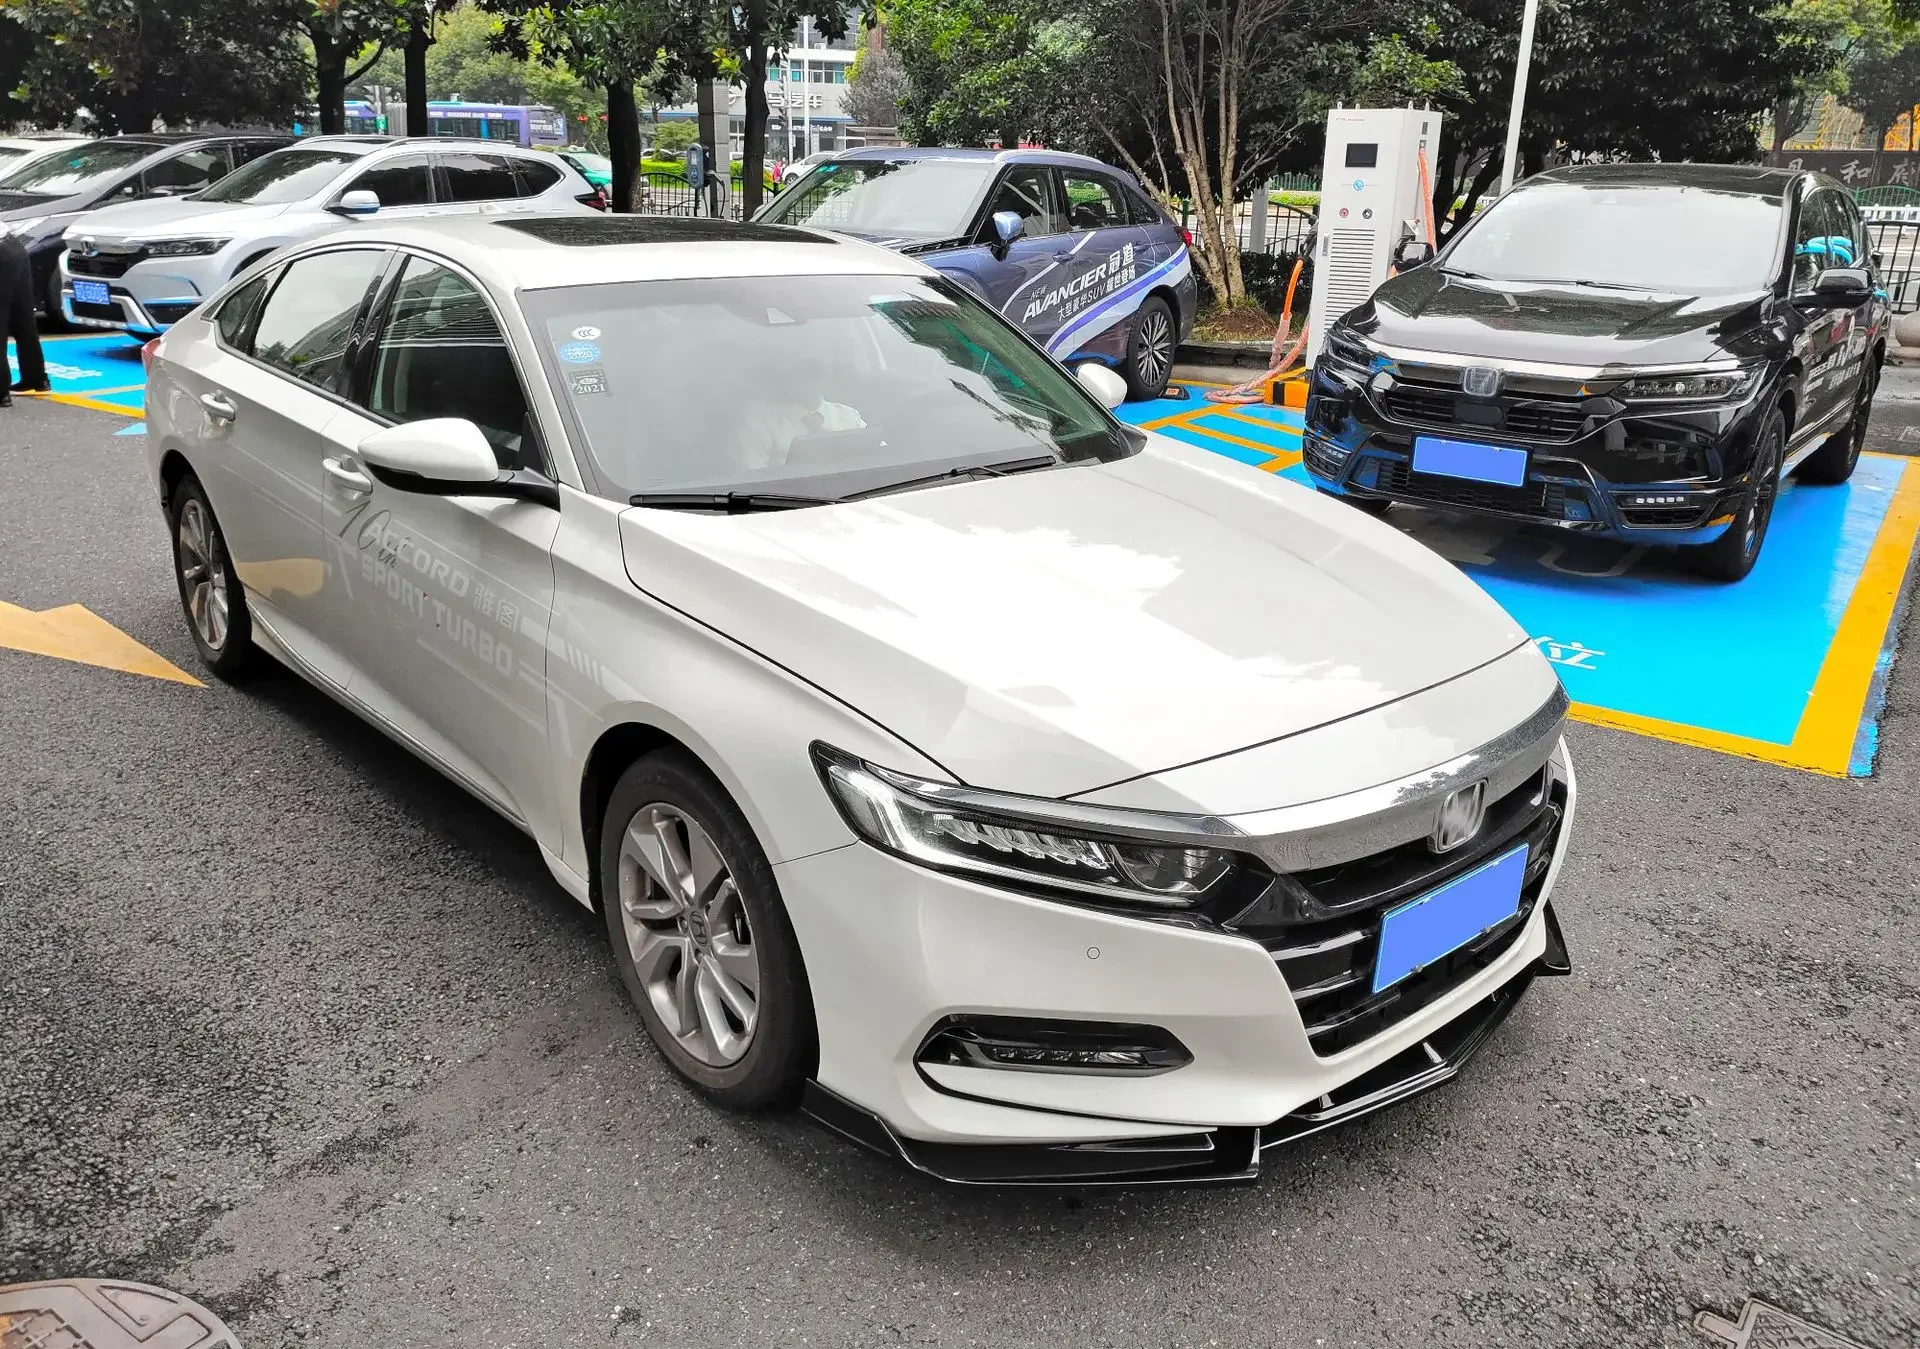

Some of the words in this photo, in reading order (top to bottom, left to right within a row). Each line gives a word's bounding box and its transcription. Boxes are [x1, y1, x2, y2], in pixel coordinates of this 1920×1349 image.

[1022, 263, 1107, 324] AVANCIER
[1108, 242, 1134, 276] 冠道
[1030, 284, 1048, 300] NEW
[569, 350, 594, 360] 2020
[576, 383, 606, 395] 2021
[361, 521, 470, 598] ACCORD
[473, 579, 521, 634] 雅阁
[361, 554, 426, 619] SPORT
[431, 597, 514, 677] TURBO
